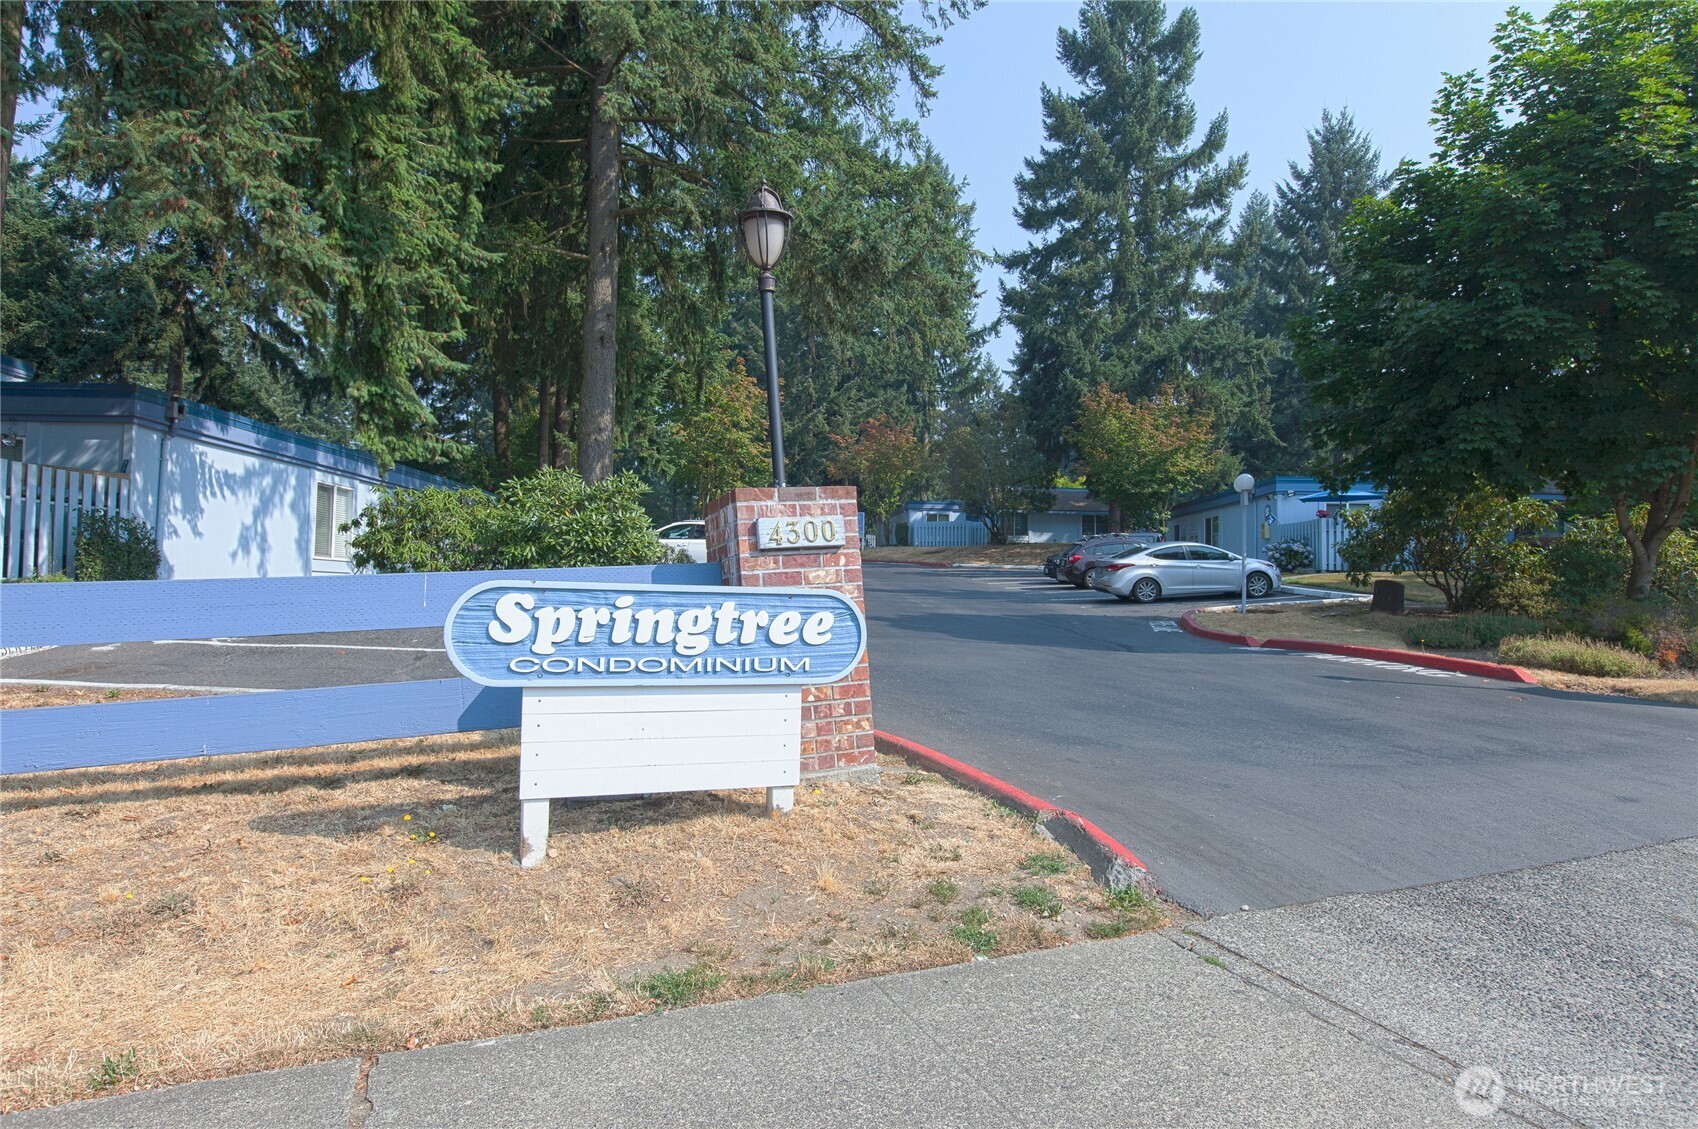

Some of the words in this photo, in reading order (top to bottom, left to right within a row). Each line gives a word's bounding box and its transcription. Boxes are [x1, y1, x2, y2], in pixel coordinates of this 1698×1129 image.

[769, 520, 836, 545] 4300
[488, 593, 834, 655] Springtree
[509, 657, 810, 674] CONDOMINIUM
